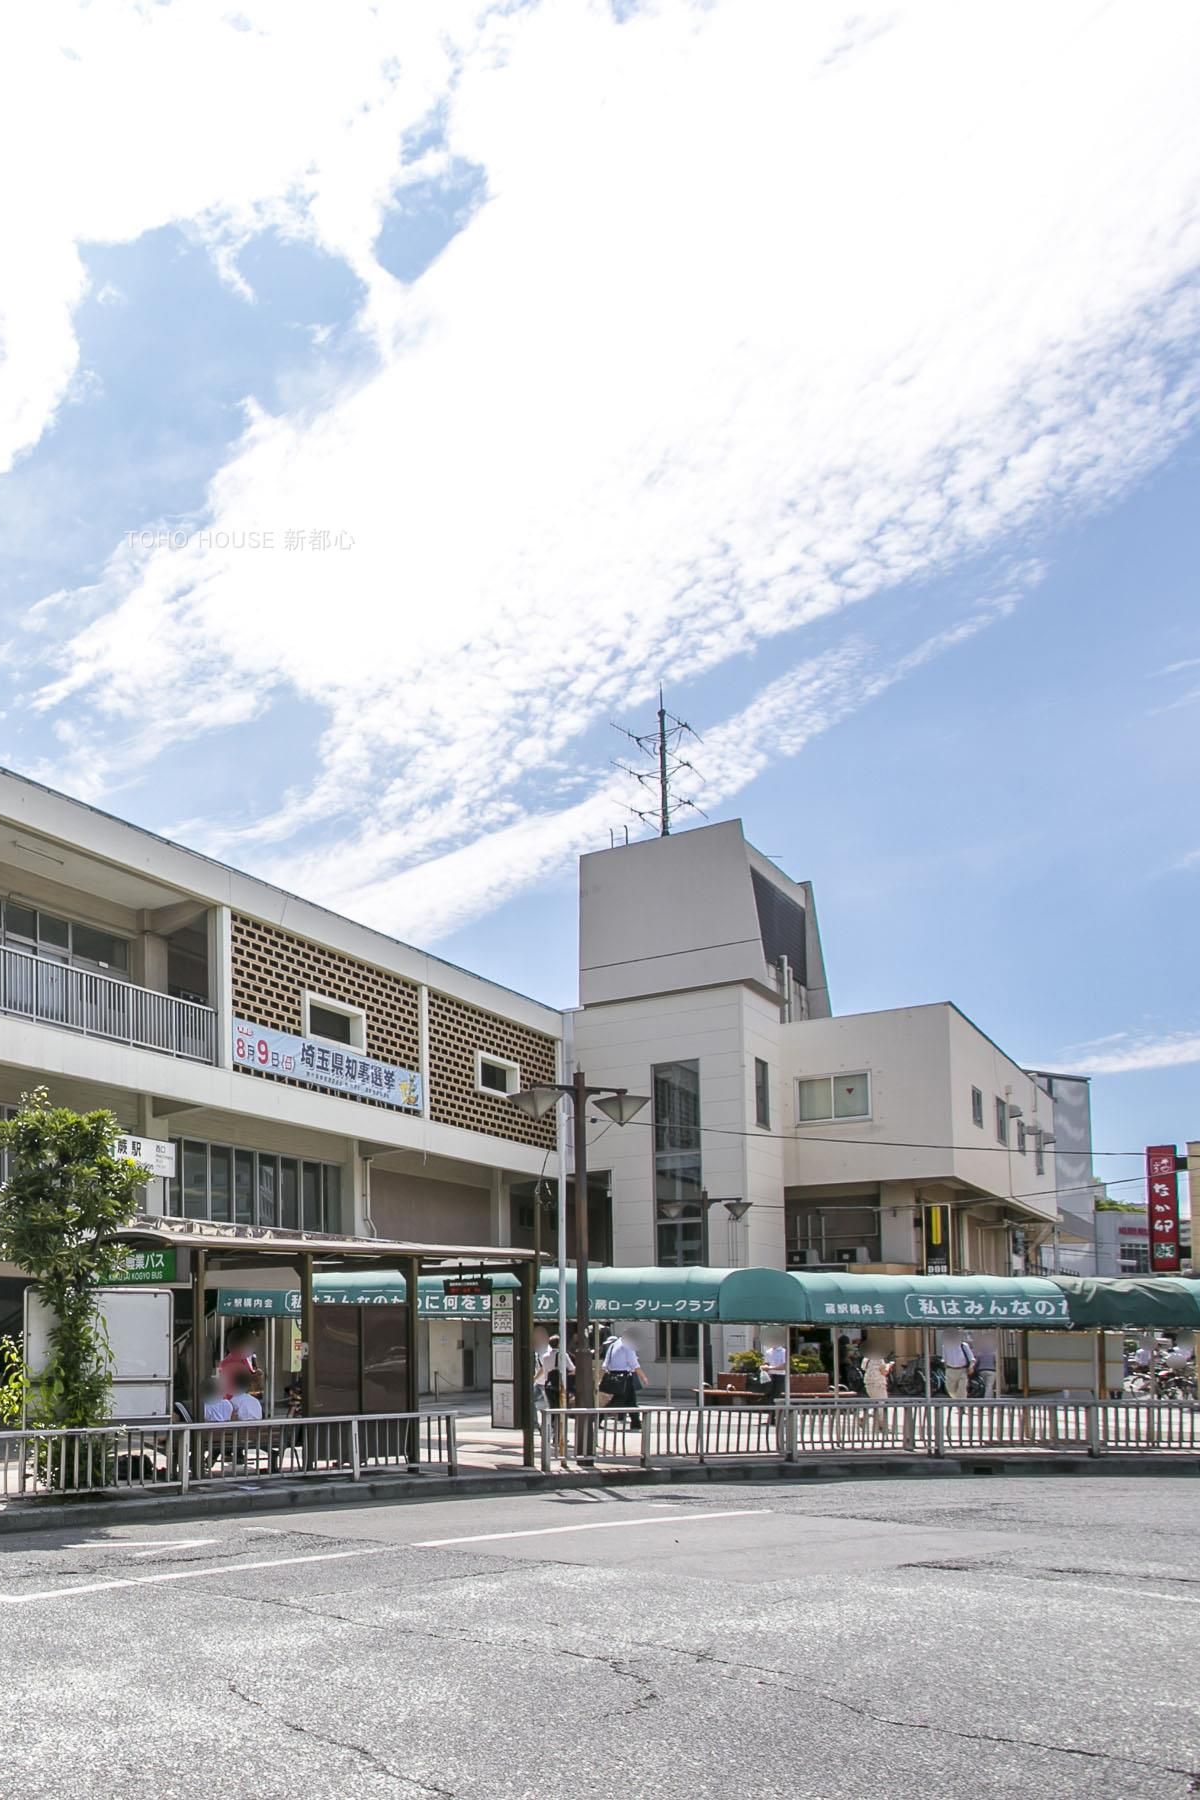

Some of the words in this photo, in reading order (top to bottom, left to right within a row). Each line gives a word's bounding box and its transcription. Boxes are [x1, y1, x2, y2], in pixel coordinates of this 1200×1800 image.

[300, 1042, 396, 1090] 埼玉県知事選挙
[151, 1271, 163, 1279] BUS
